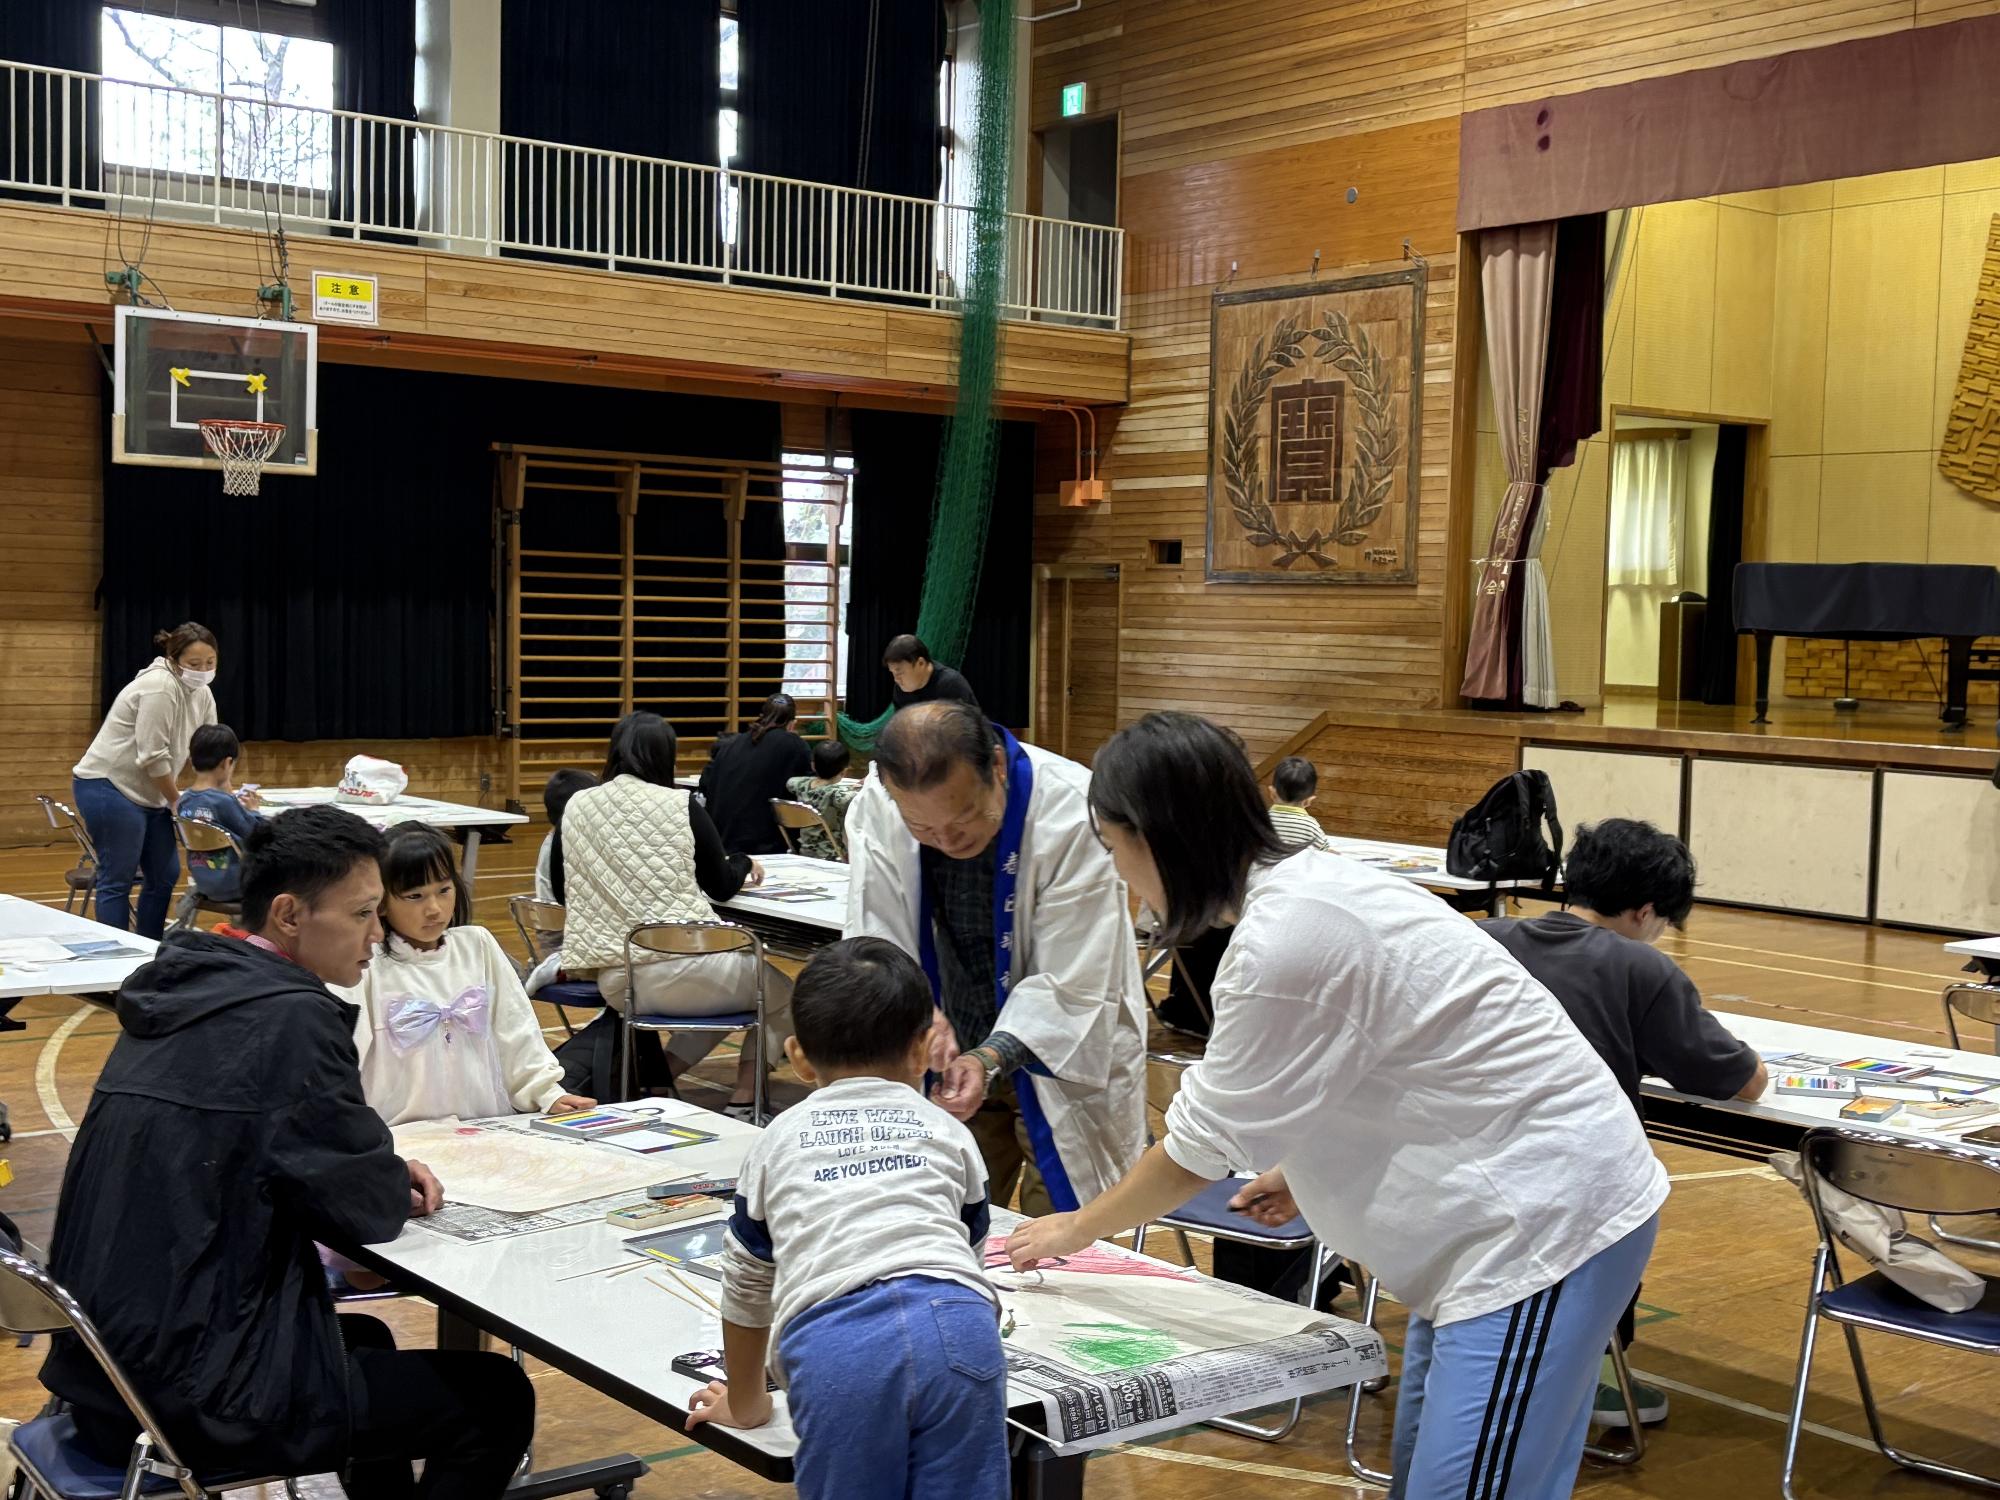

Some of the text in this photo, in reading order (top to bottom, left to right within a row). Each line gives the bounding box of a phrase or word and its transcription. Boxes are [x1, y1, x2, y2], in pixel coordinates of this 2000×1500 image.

[331, 282, 360, 296] 注意
[810, 1109, 924, 1128] LIVE WELL,
[799, 1127, 864, 1149] LAUGH
[814, 1154, 928, 1182] ARE YOU EXCITED?
